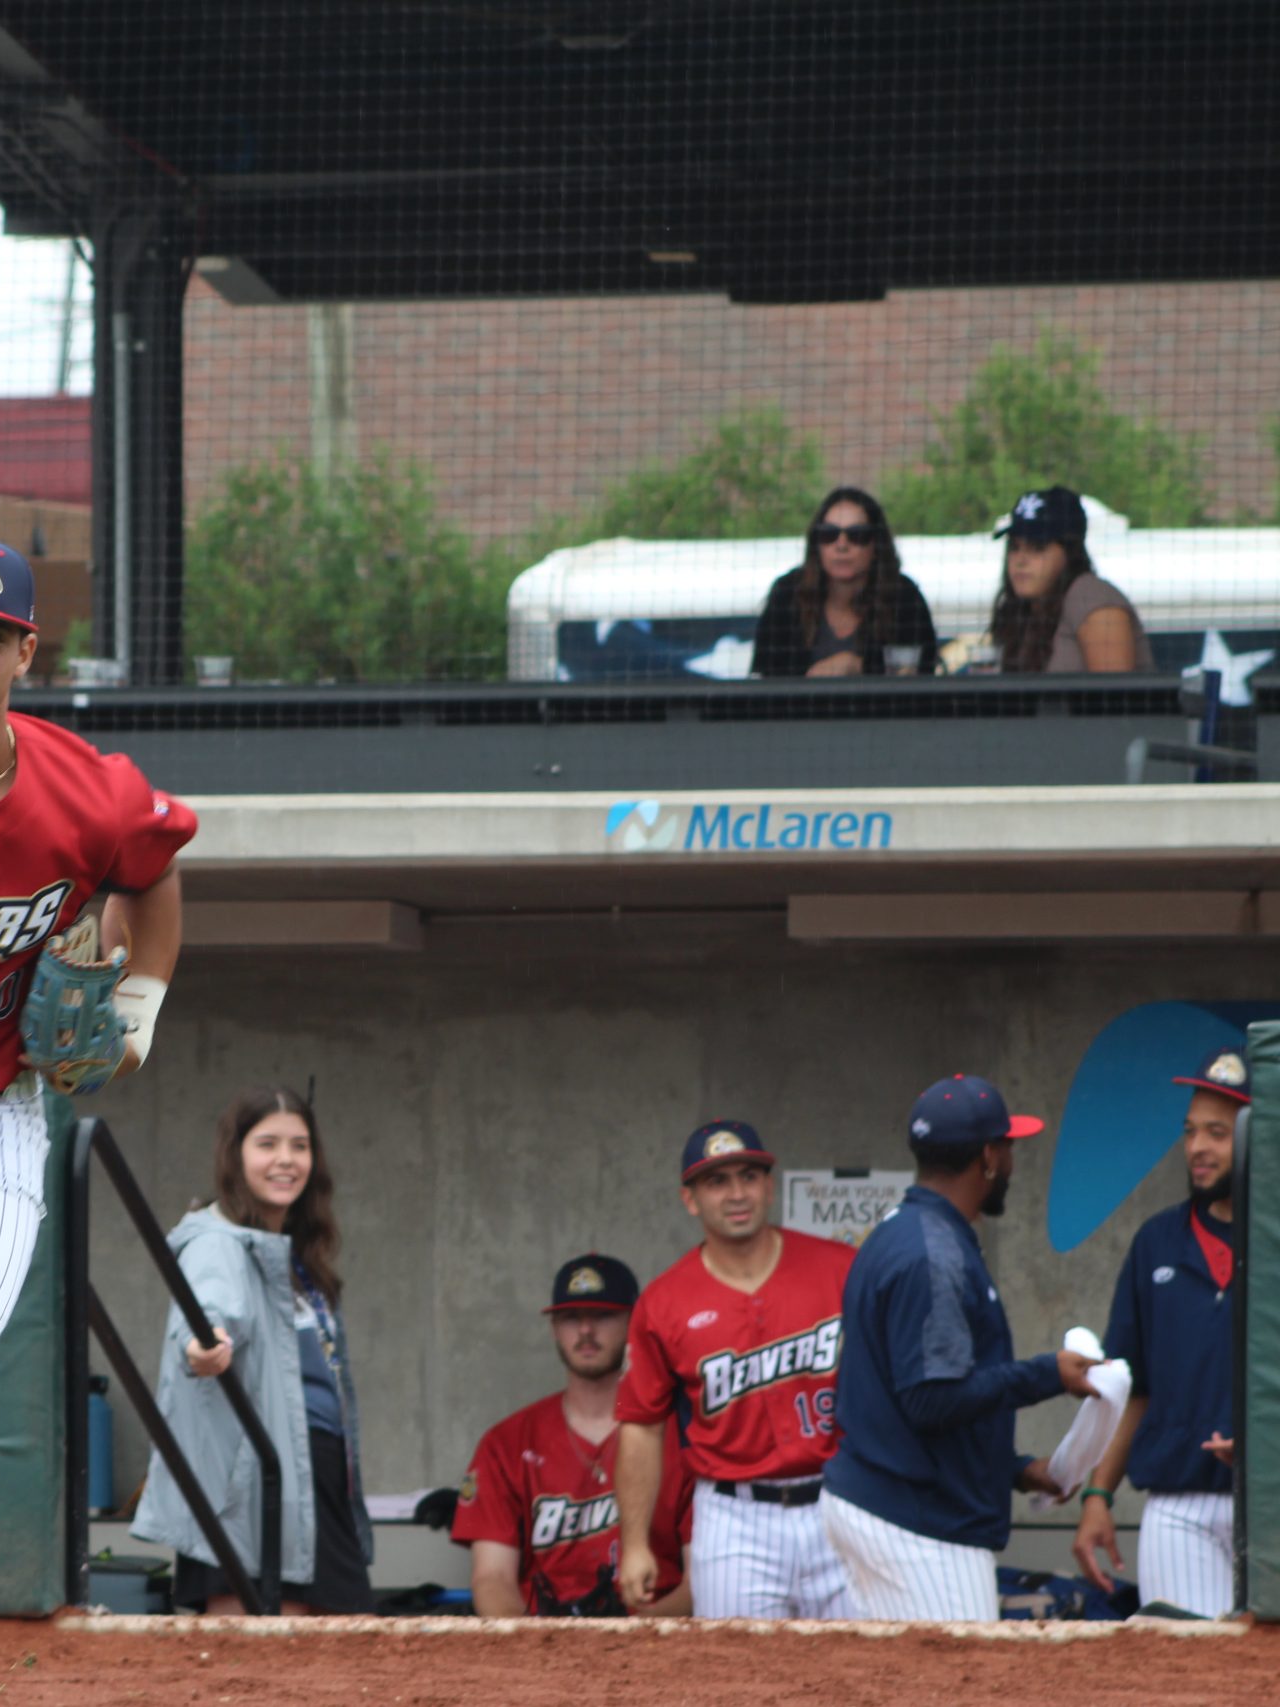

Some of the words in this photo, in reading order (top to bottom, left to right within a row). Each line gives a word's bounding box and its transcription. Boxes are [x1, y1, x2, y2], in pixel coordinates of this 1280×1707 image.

[683, 804, 893, 850] McLaren
[811, 1201, 890, 1225] MASK
[699, 1315, 843, 1416] BEAVERS
[794, 1388, 836, 1438] 19
